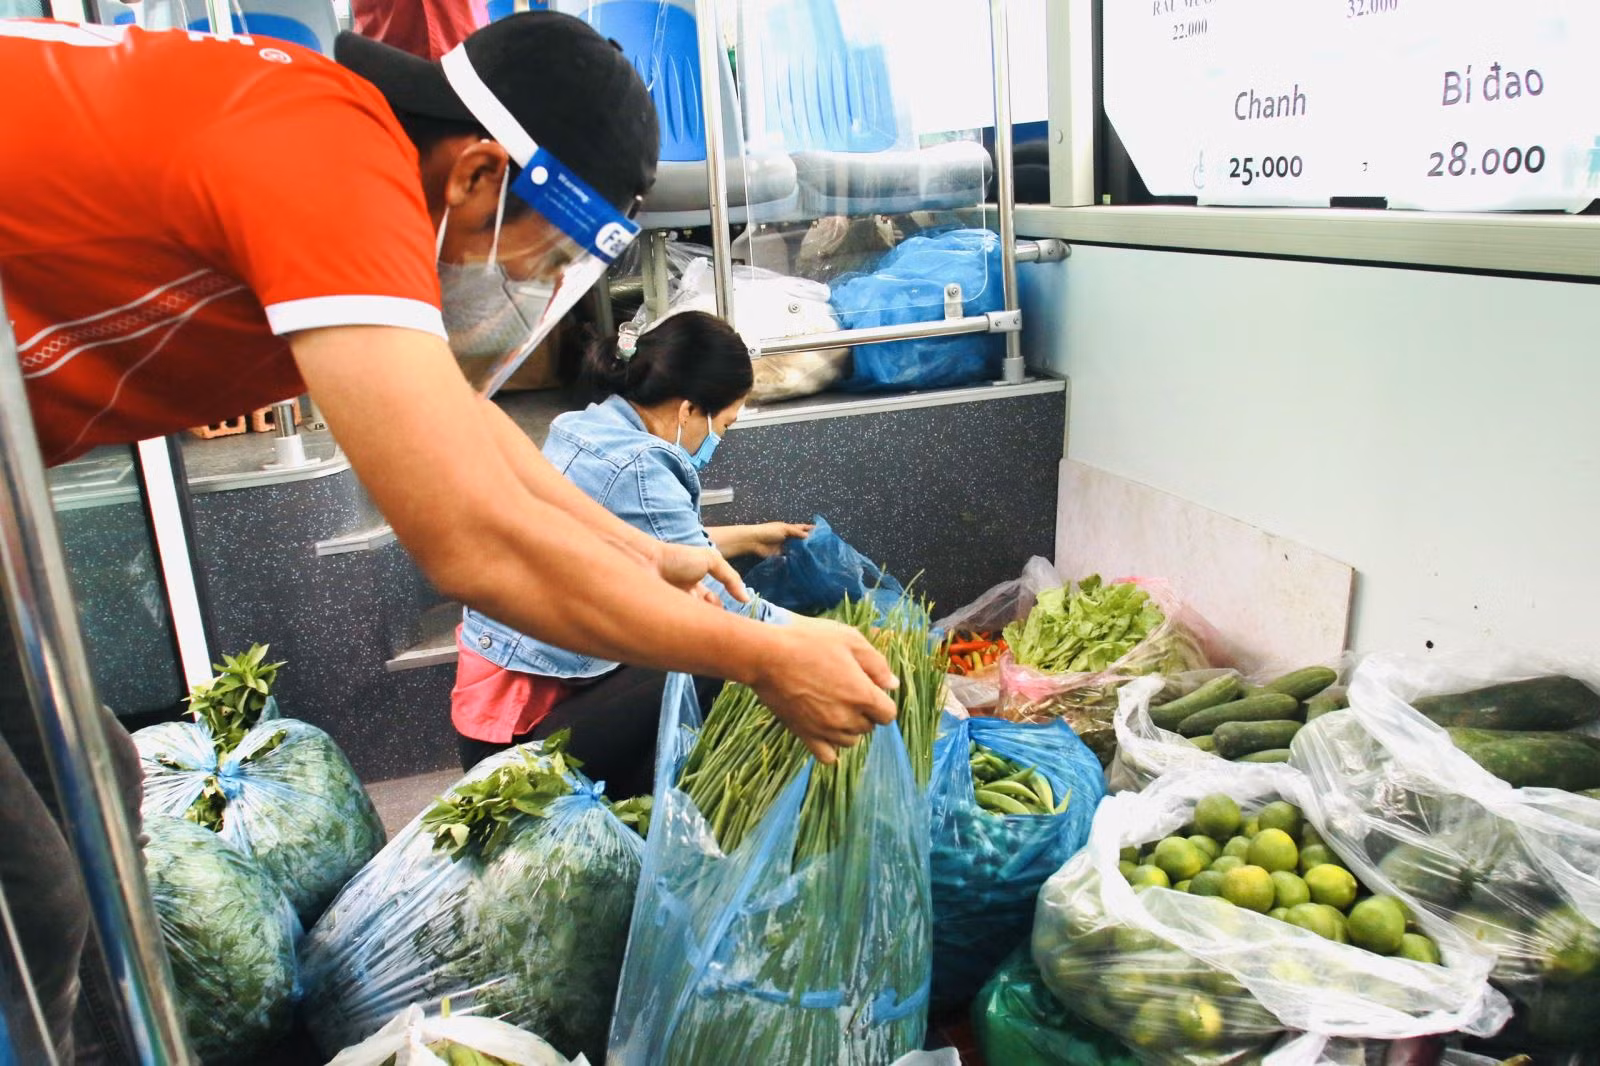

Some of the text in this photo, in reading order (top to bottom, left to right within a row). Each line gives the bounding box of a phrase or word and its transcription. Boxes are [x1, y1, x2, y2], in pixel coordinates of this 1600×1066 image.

[1172, 19, 1208, 41] 22.000
[1442, 61, 1544, 106] Bí đao
[1234, 84, 1306, 121] Chanh
[1229, 155, 1303, 186] 25.000
[1427, 141, 1546, 177] 28.000
